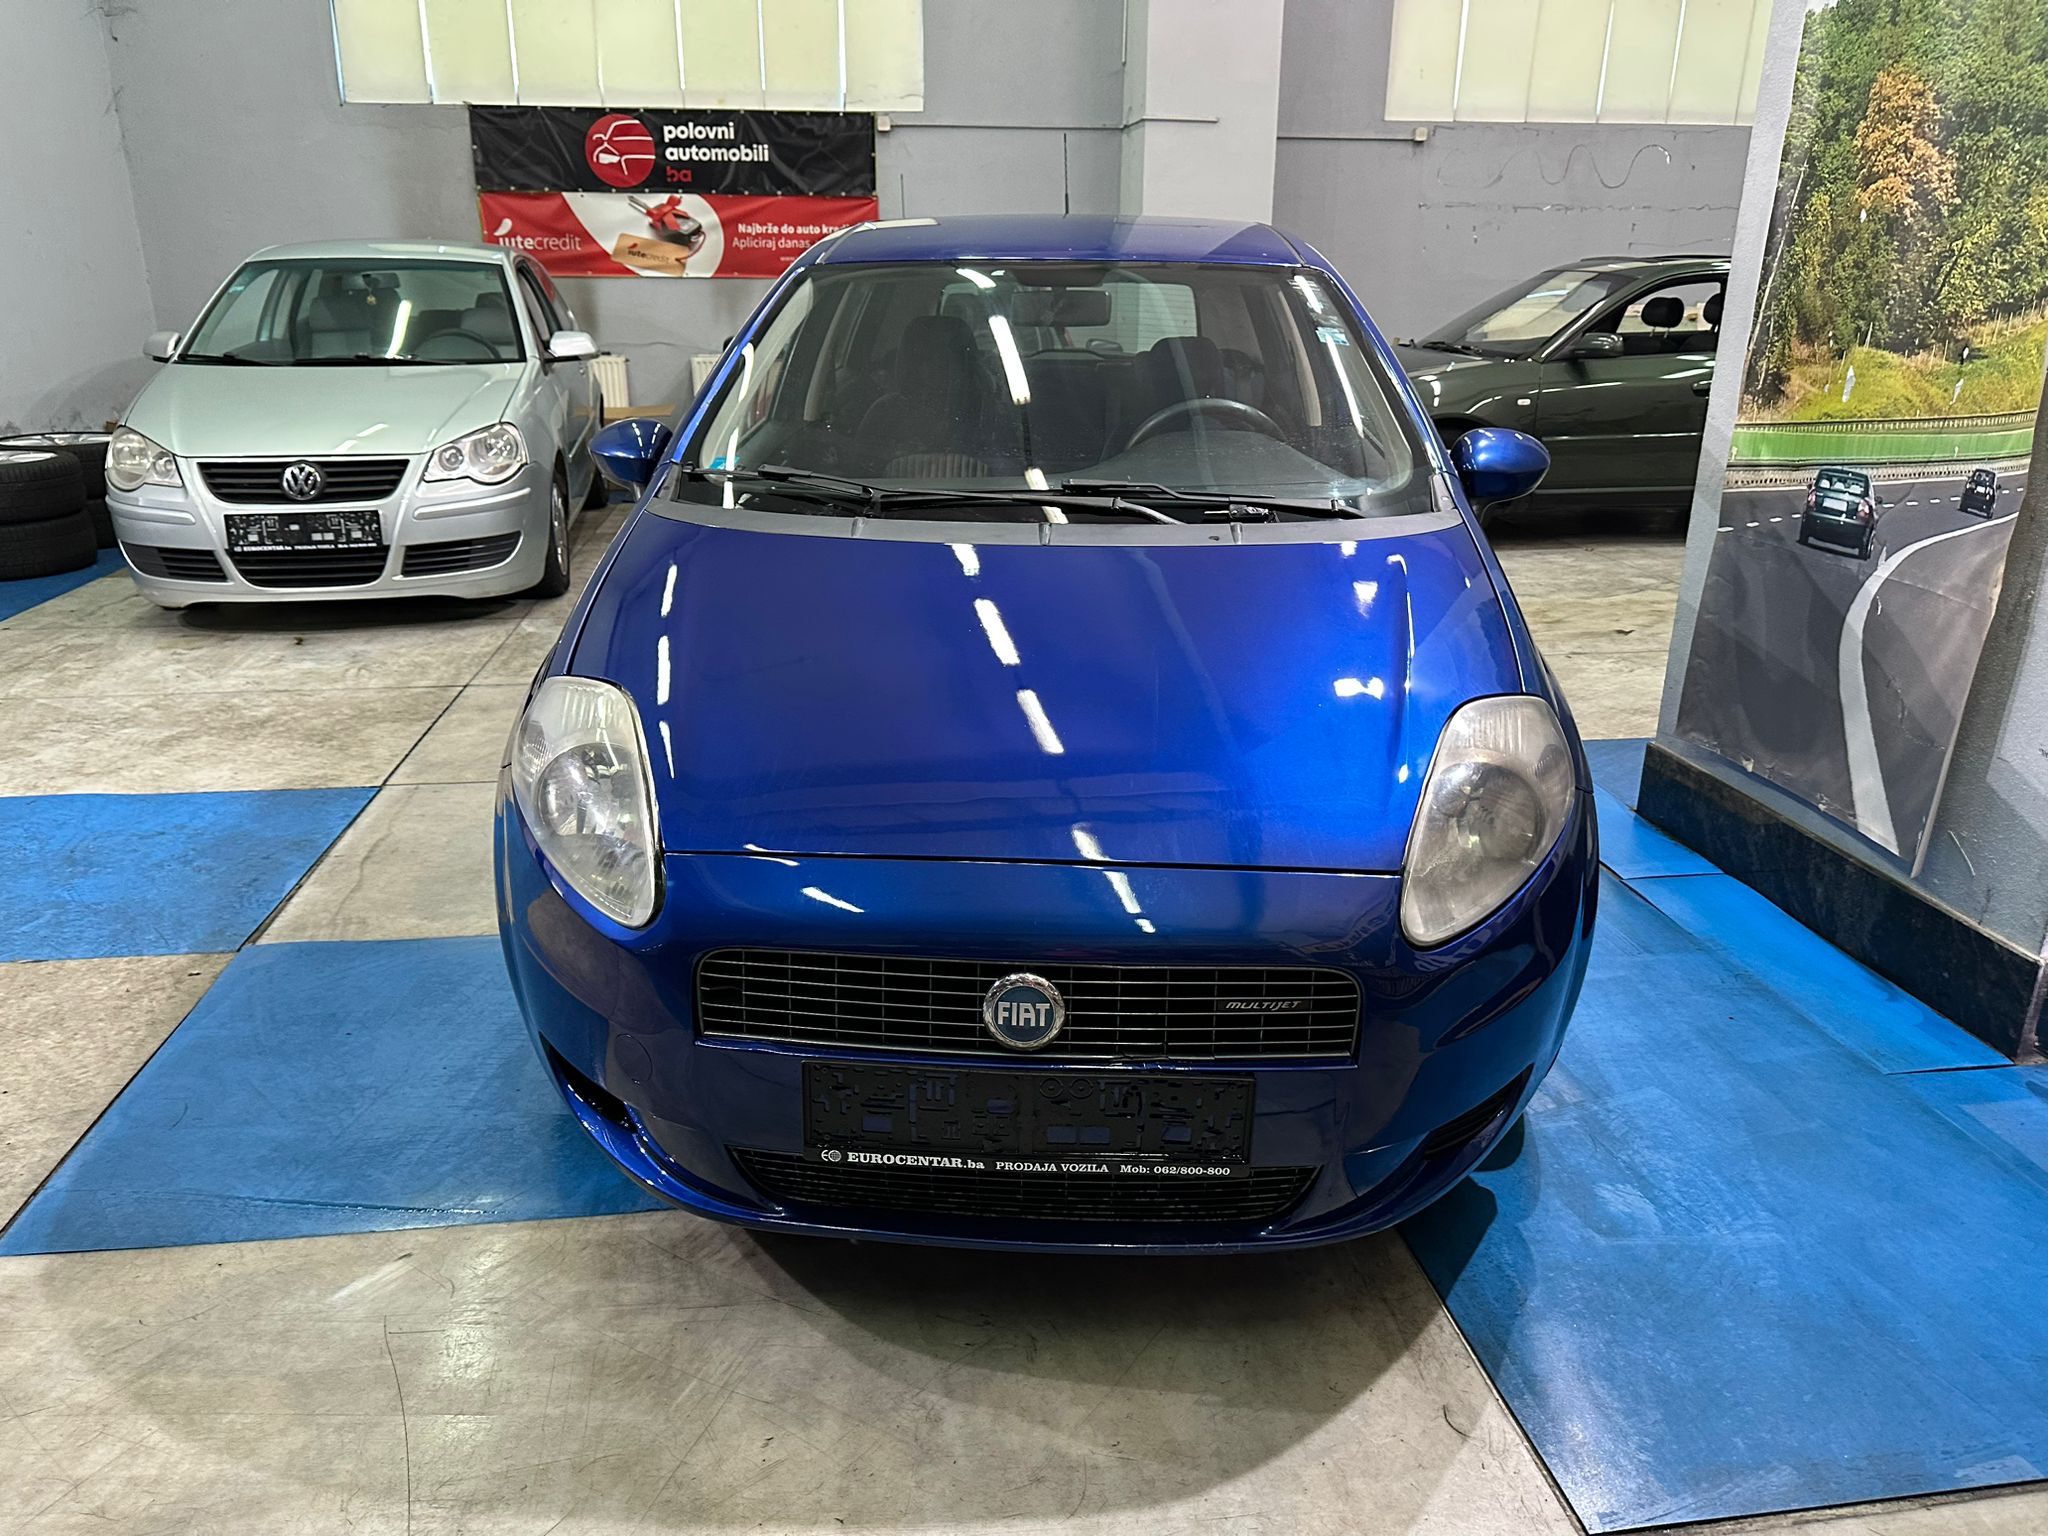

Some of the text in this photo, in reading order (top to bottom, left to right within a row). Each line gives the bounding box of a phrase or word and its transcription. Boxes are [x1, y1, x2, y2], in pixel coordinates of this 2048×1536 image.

[663, 121, 735, 143] polovni
[665, 144, 769, 162] automobili
[666, 165, 692, 182] ba
[738, 223, 779, 235] Najbrže
[780, 223, 793, 234] do
[796, 224, 820, 235] auto
[732, 236, 811, 251] Apliciraj danas
[997, 1001, 1051, 1027] FIAT
[1225, 1000, 1302, 1011] MULTIJET
[847, 1151, 1231, 1176] EUROCENTAR.ba PRODAJA VOZILA Mob: 062/800-800
